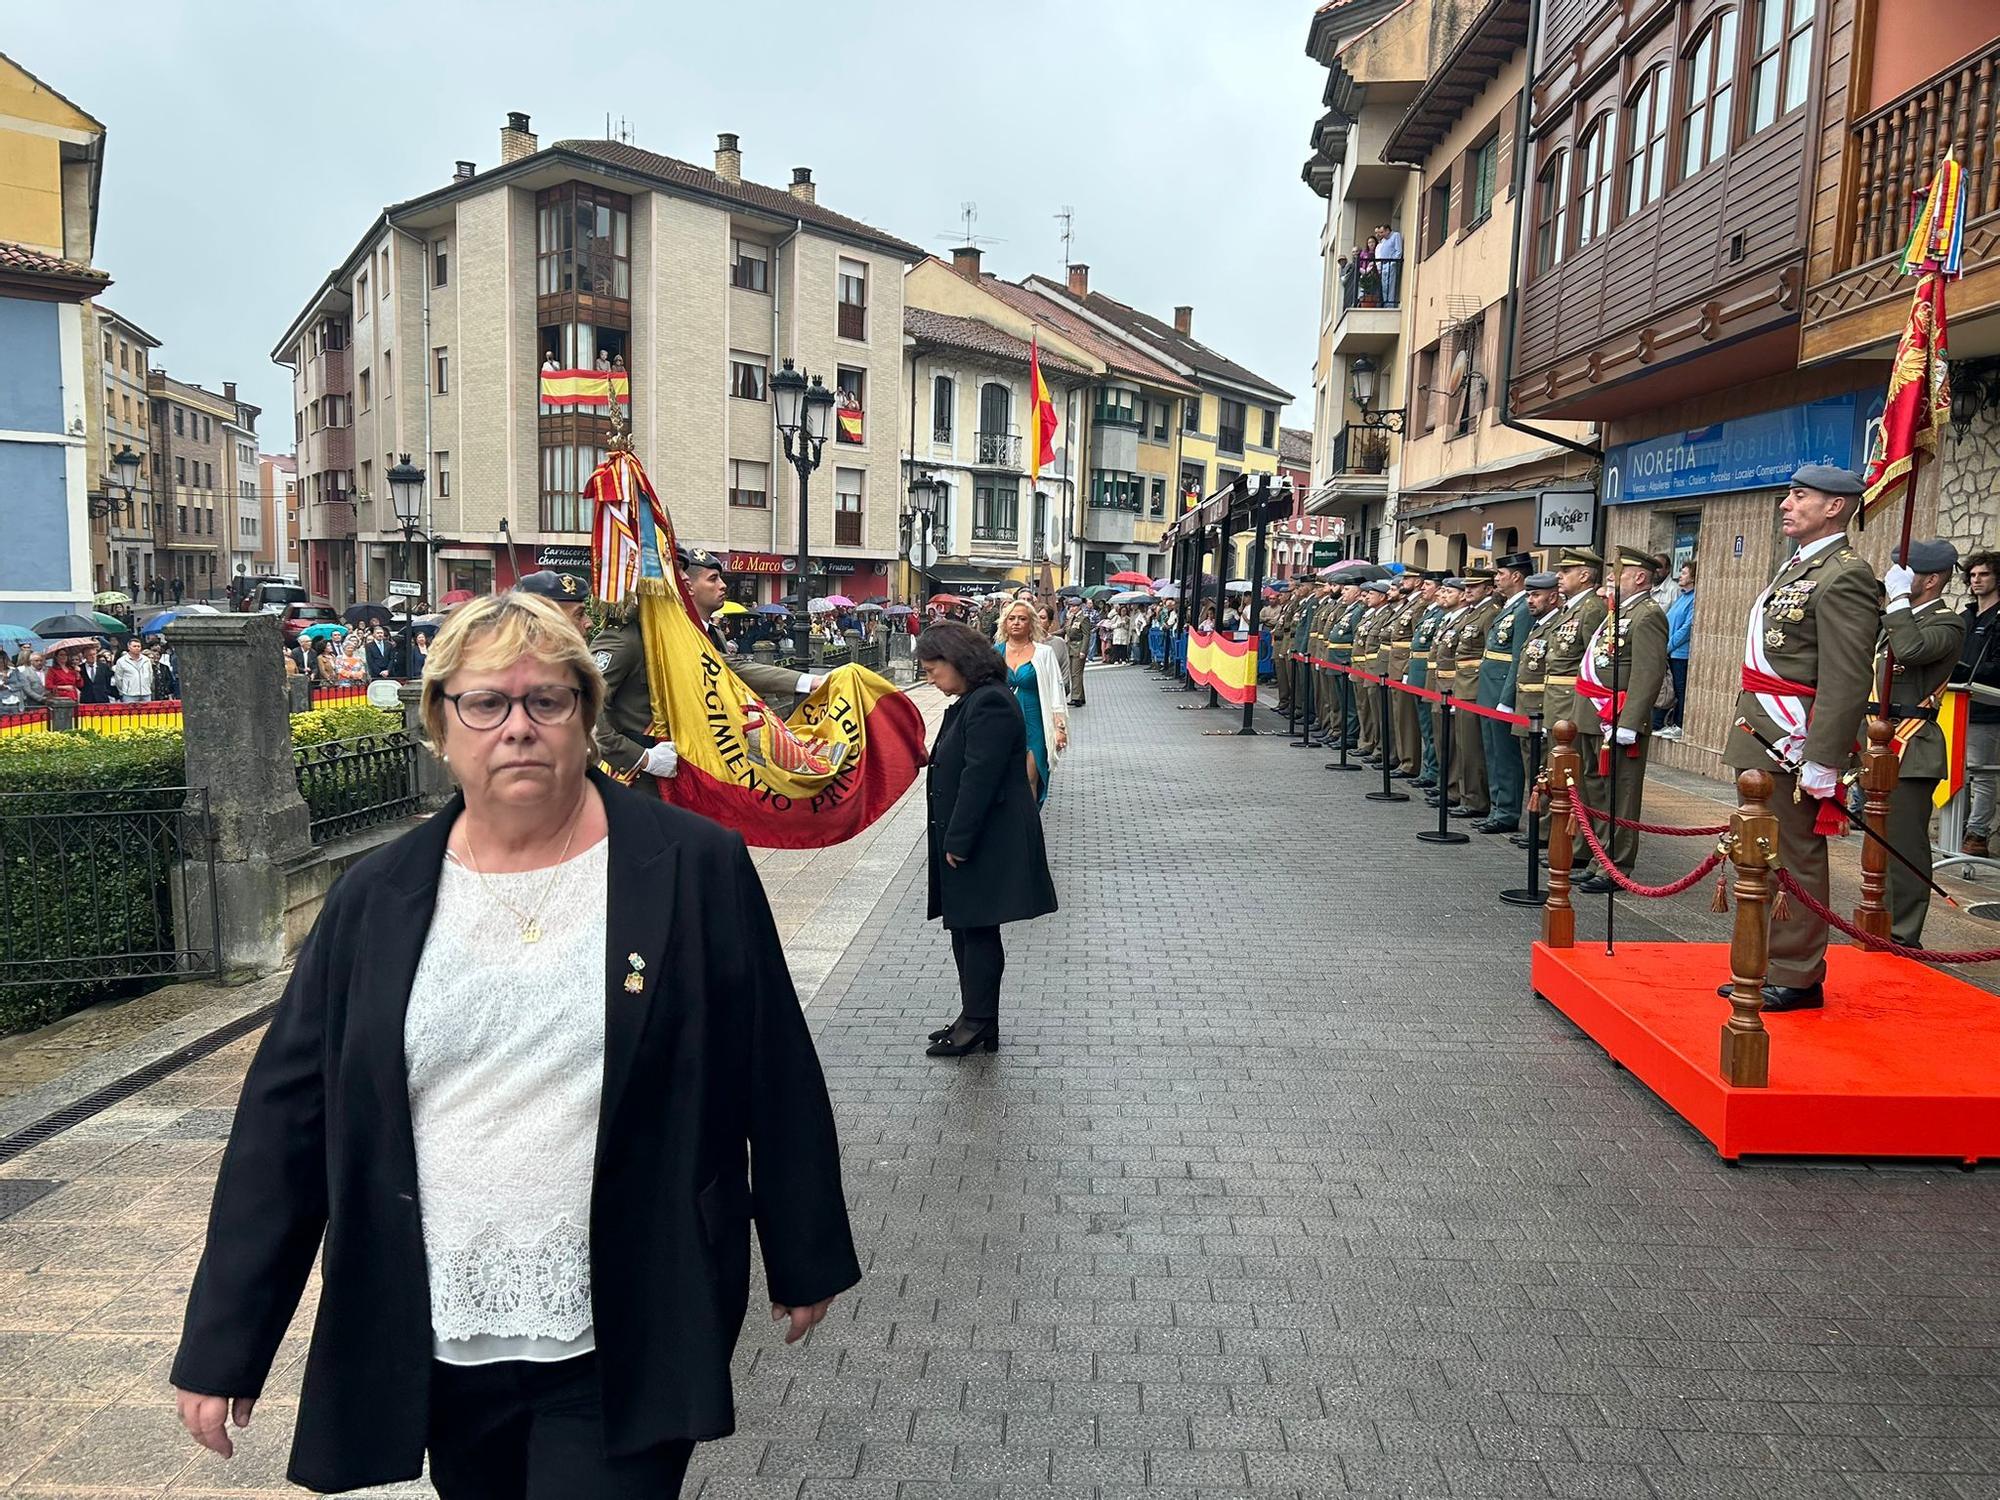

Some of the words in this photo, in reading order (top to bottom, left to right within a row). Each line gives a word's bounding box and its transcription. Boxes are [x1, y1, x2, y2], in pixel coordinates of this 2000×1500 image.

[1735, 466, 1754, 480] Locales
[1756, 461, 1792, 476] Comerciales
[731, 556, 744, 570] de
[747, 557, 781, 571] Marco
